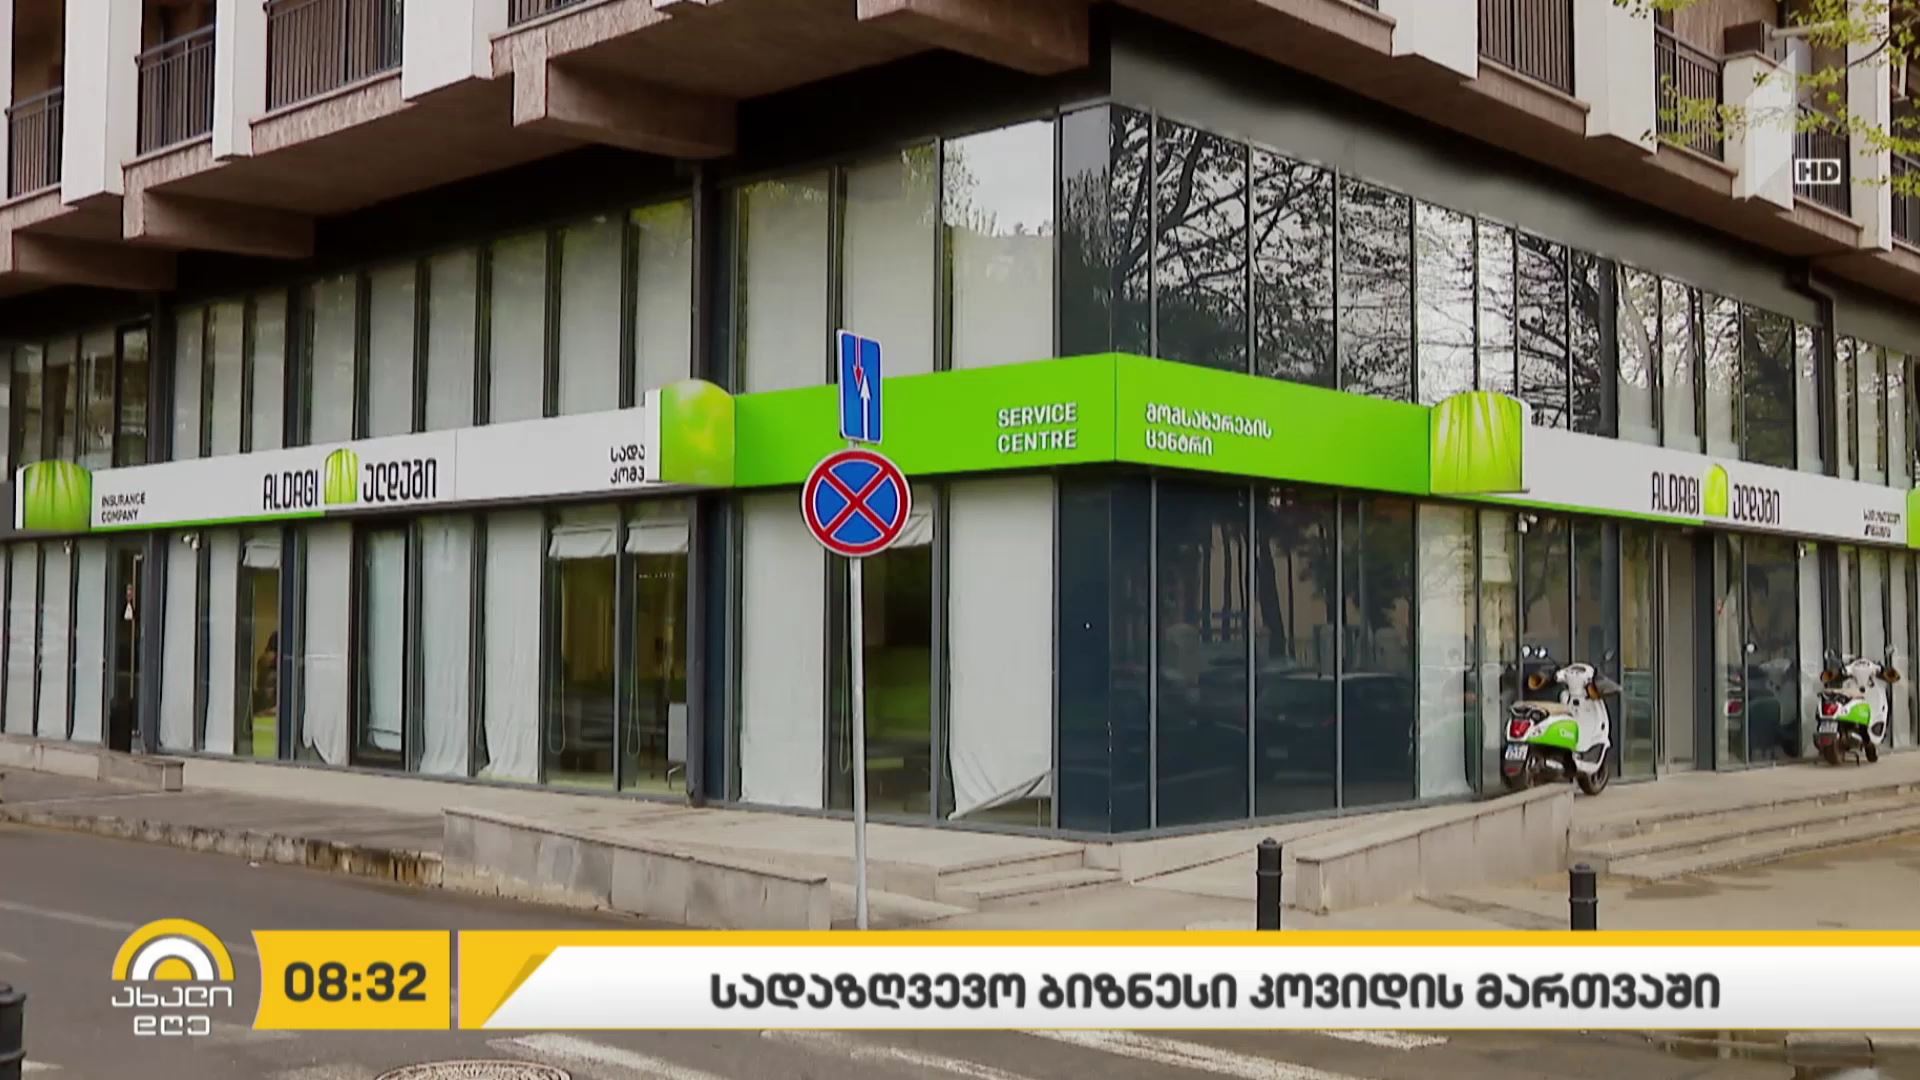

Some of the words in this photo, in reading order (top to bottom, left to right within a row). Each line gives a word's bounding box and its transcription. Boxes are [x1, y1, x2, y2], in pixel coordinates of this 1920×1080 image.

[998, 402, 1077, 427] SERVICE
[1146, 402, 1273, 439] მომსახურების
[998, 428, 1077, 453] CENTRE
[1145, 429, 1213, 456] ცენტრი
[263, 469, 319, 511] ALDAGI
[363, 458, 437, 502] ალდაგი
[1651, 471, 1700, 515] ALDAGI
[102, 491, 146, 507] INSURANCE
[1733, 482, 1780, 525] ალდაგი
[102, 508, 139, 523] COMPANY
